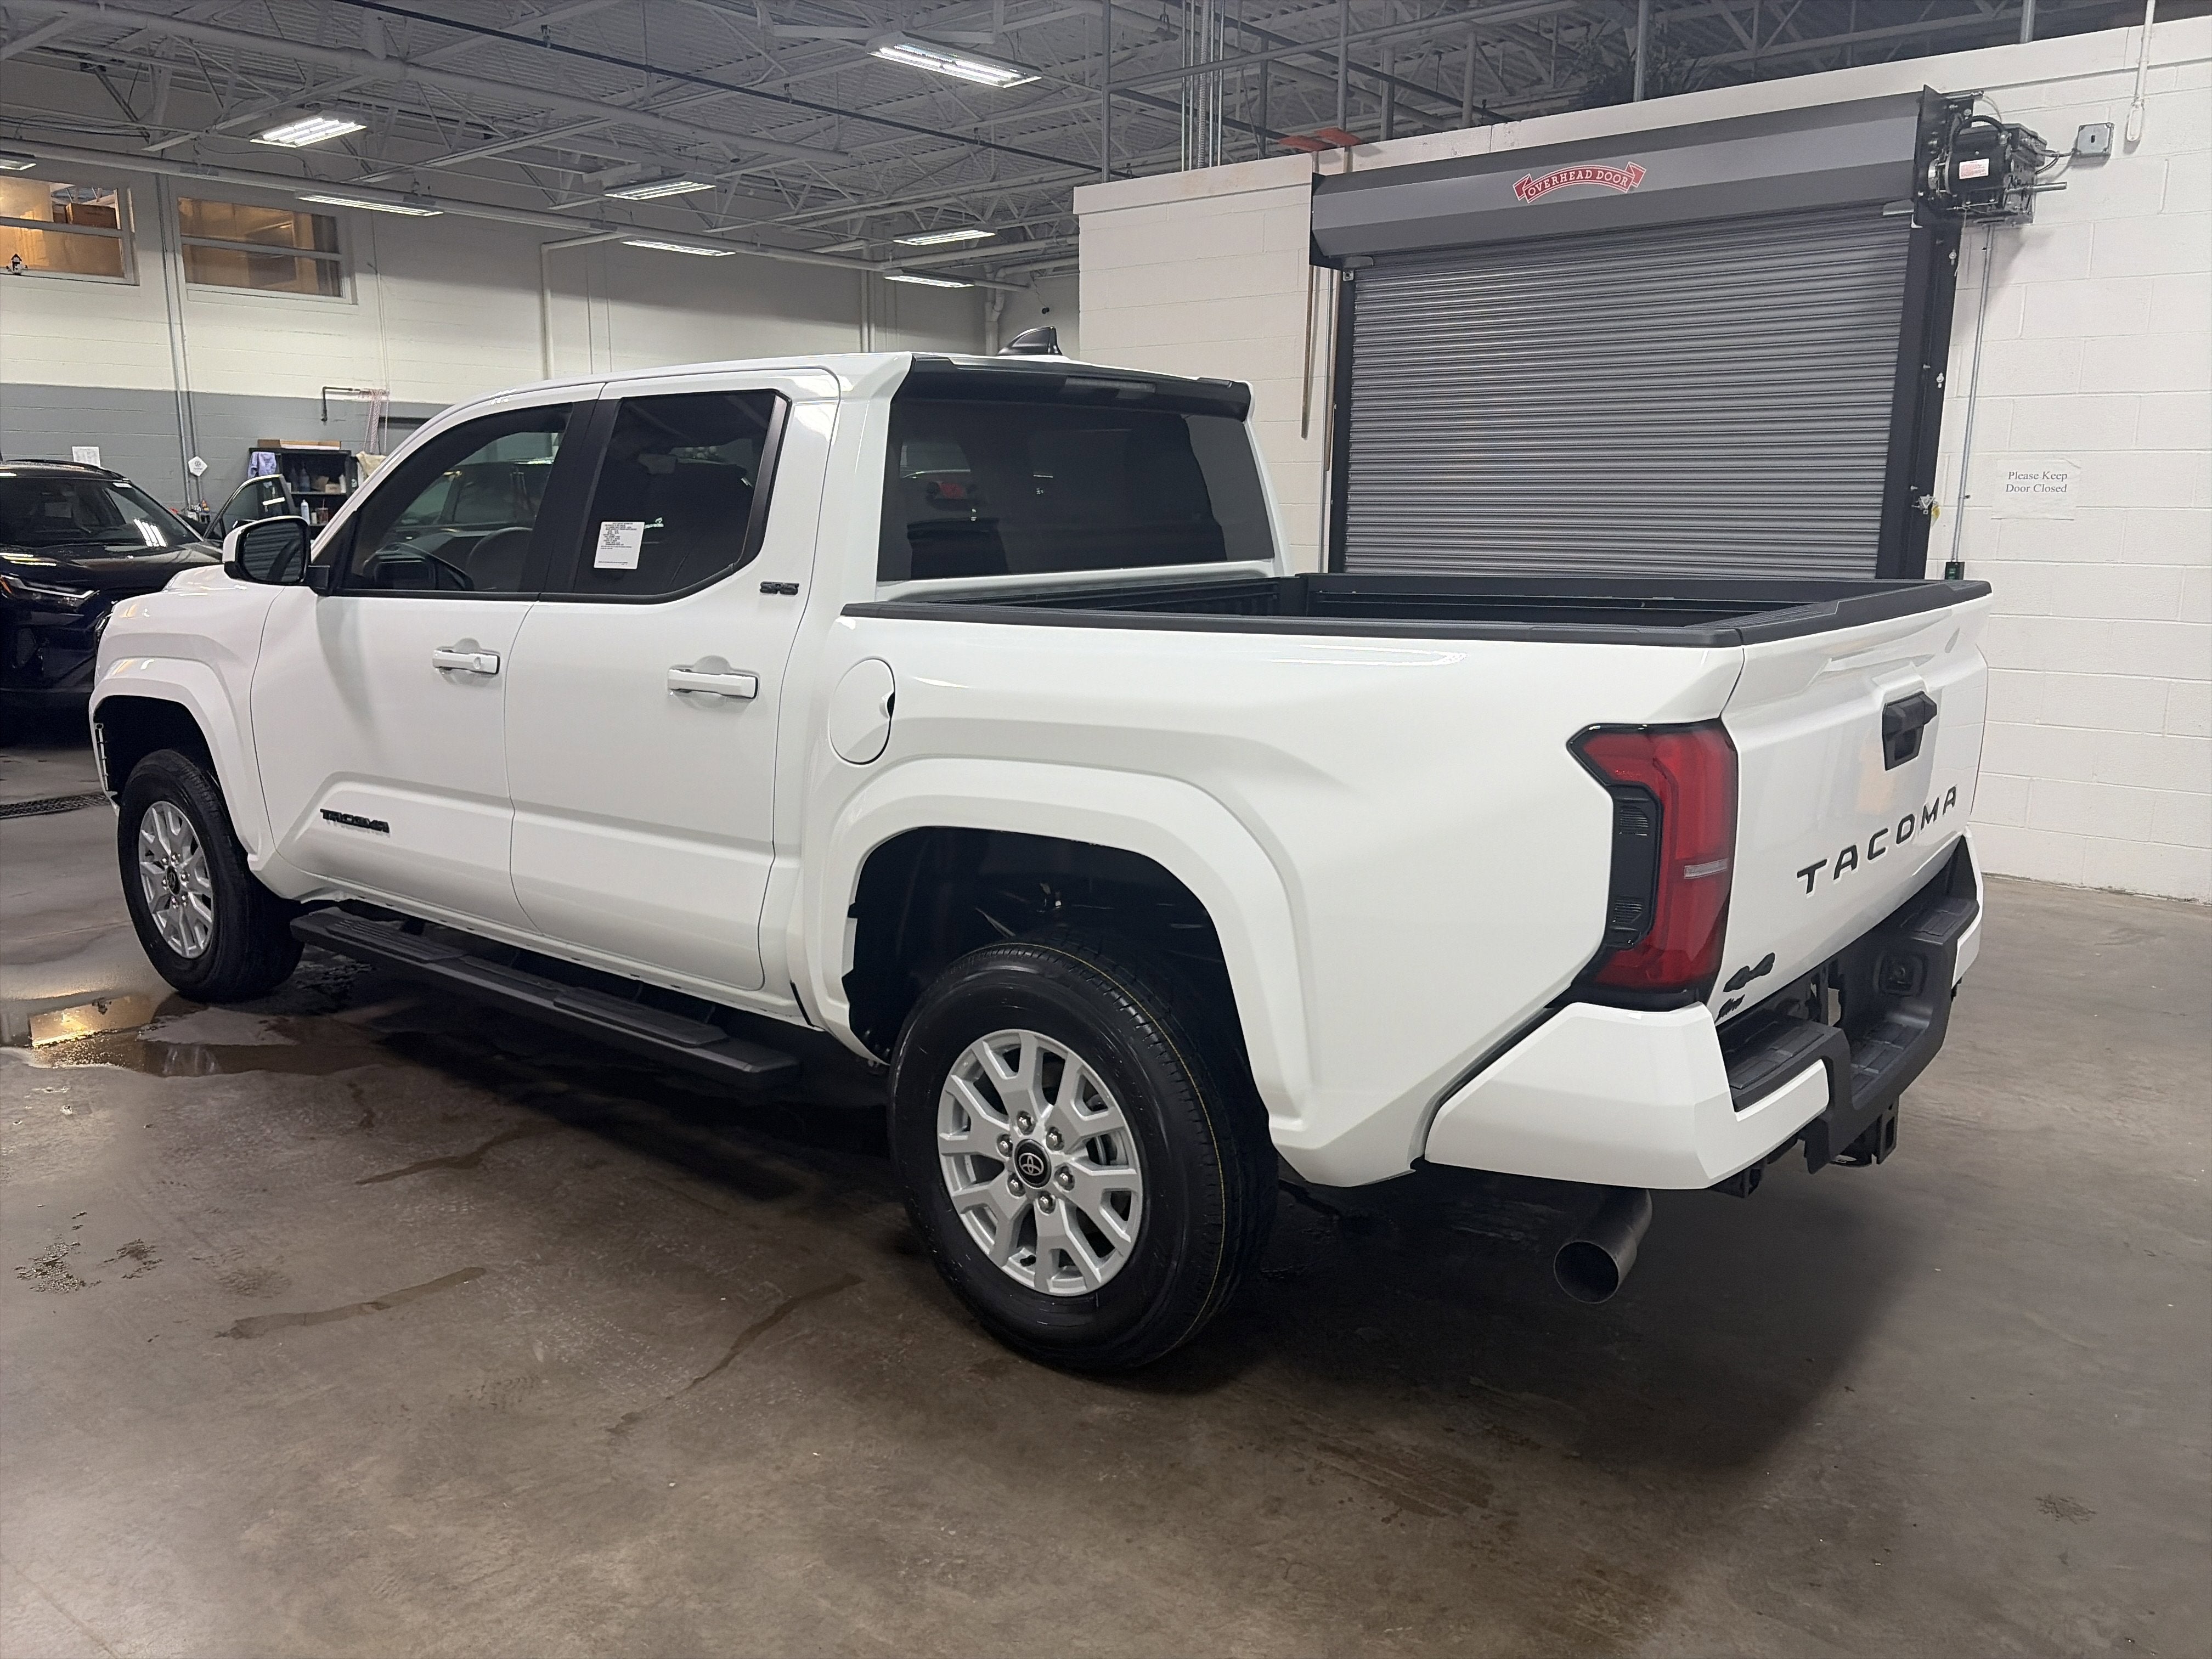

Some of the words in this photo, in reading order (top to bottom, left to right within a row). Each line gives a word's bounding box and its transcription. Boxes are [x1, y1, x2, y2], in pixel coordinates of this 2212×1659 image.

[1527, 170, 1592, 196] OVERHEAD
[1595, 171, 1629, 187] DOOR
[2008, 471, 2039, 480] Please
[2041, 471, 2068, 482] Keep
[2005, 483, 2031, 493] Door
[2033, 483, 2067, 493] Closed
[1797, 785, 1957, 895] TACOMA
